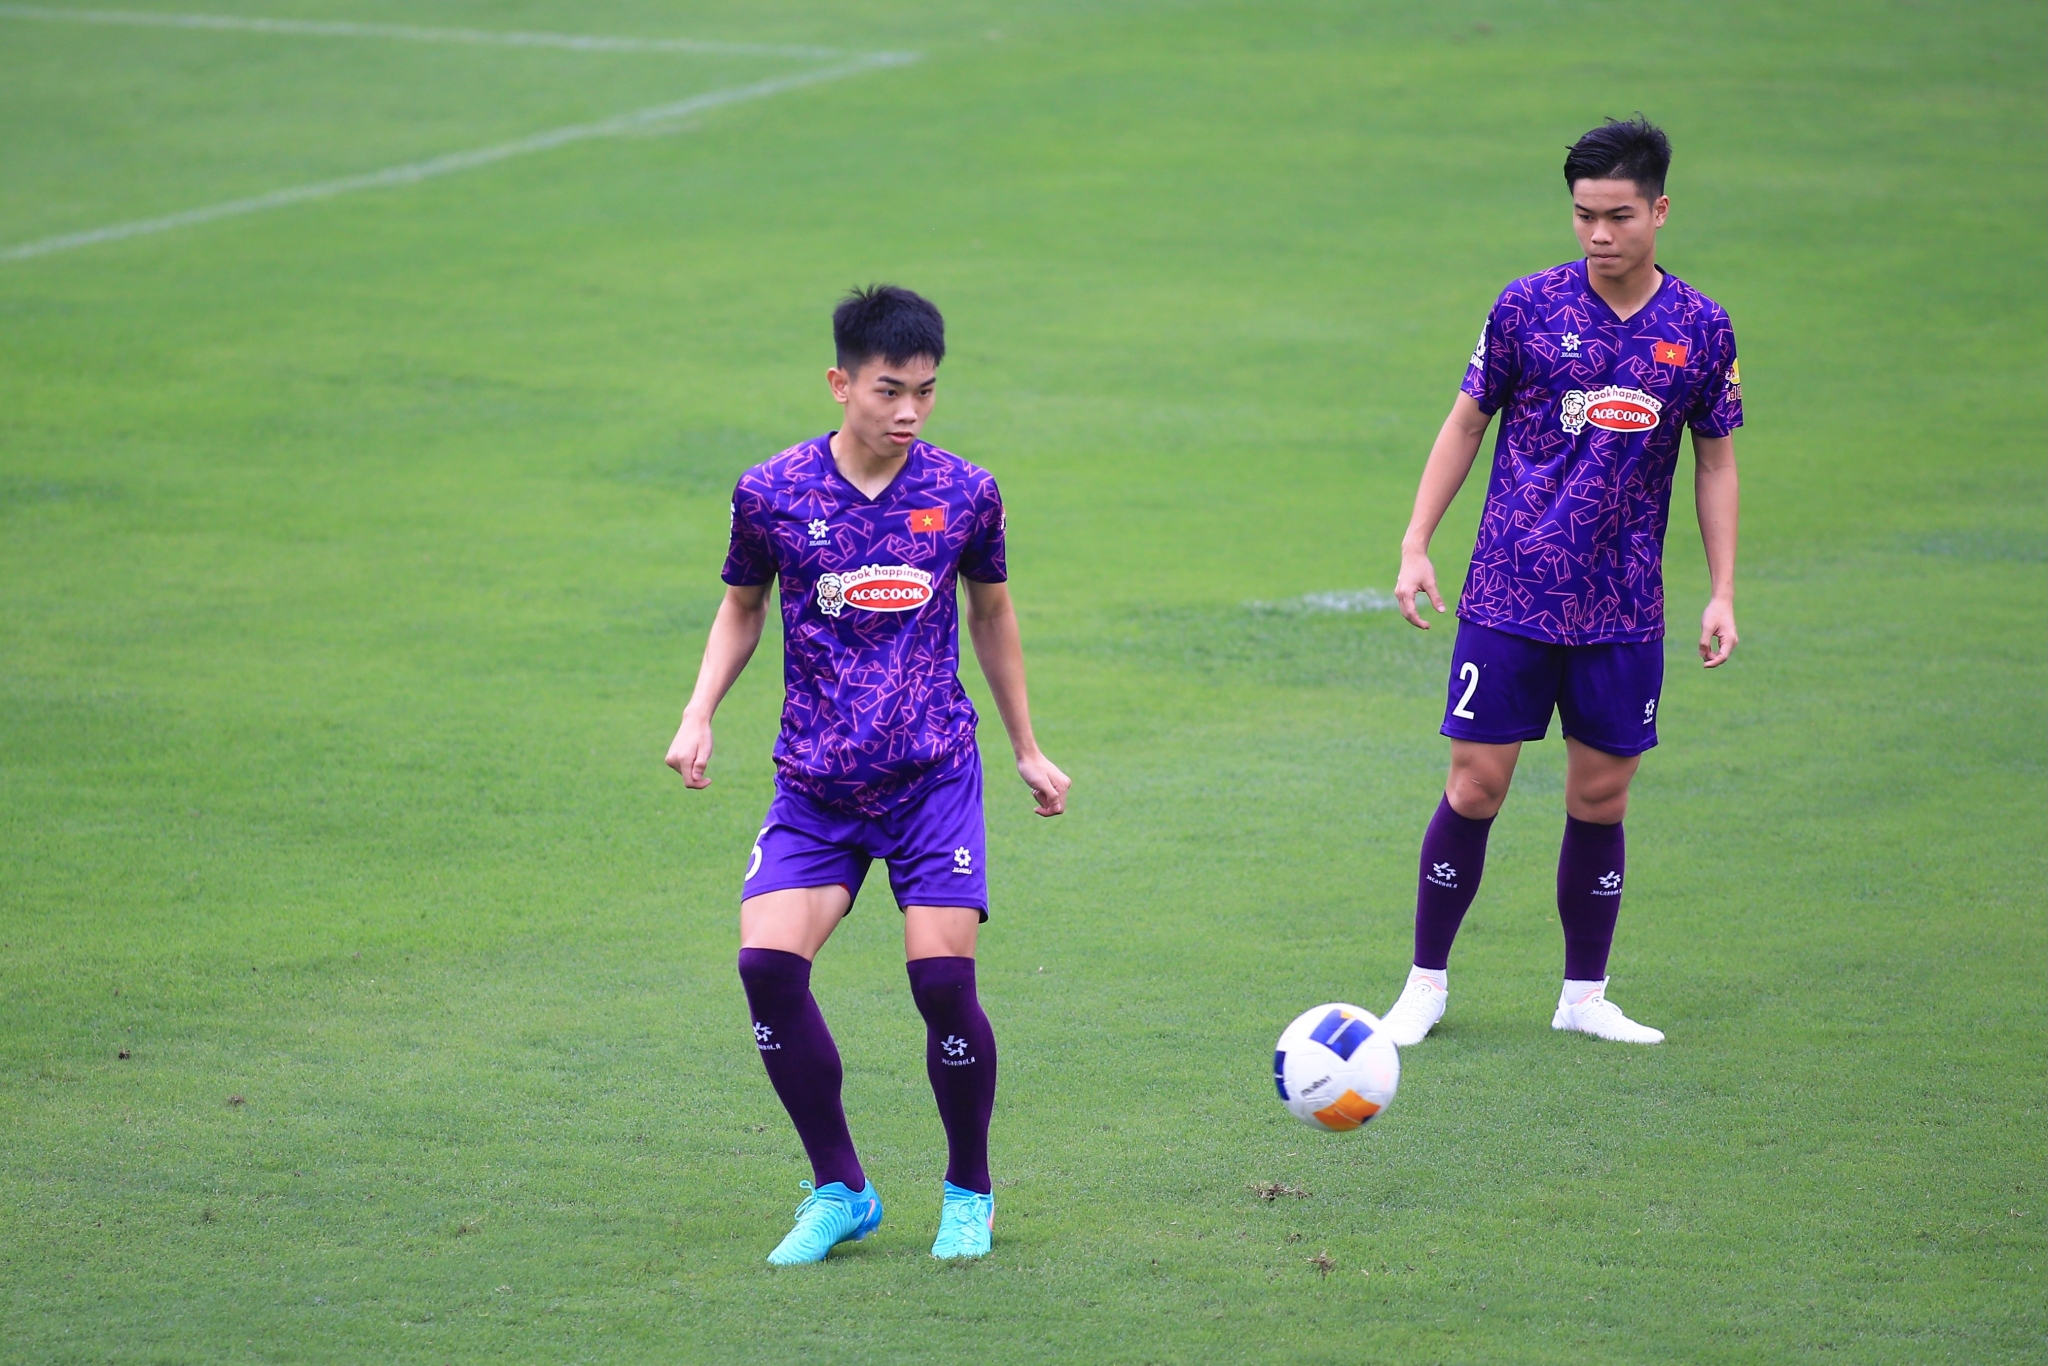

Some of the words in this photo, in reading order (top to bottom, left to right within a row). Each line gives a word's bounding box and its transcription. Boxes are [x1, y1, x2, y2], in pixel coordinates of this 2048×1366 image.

[1587, 388, 1611, 402] Cook
[1613, 388, 1660, 410] happiness
[843, 570, 871, 584] Cook
[874, 567, 930, 582] happiness
[1452, 661, 1480, 720] 2
